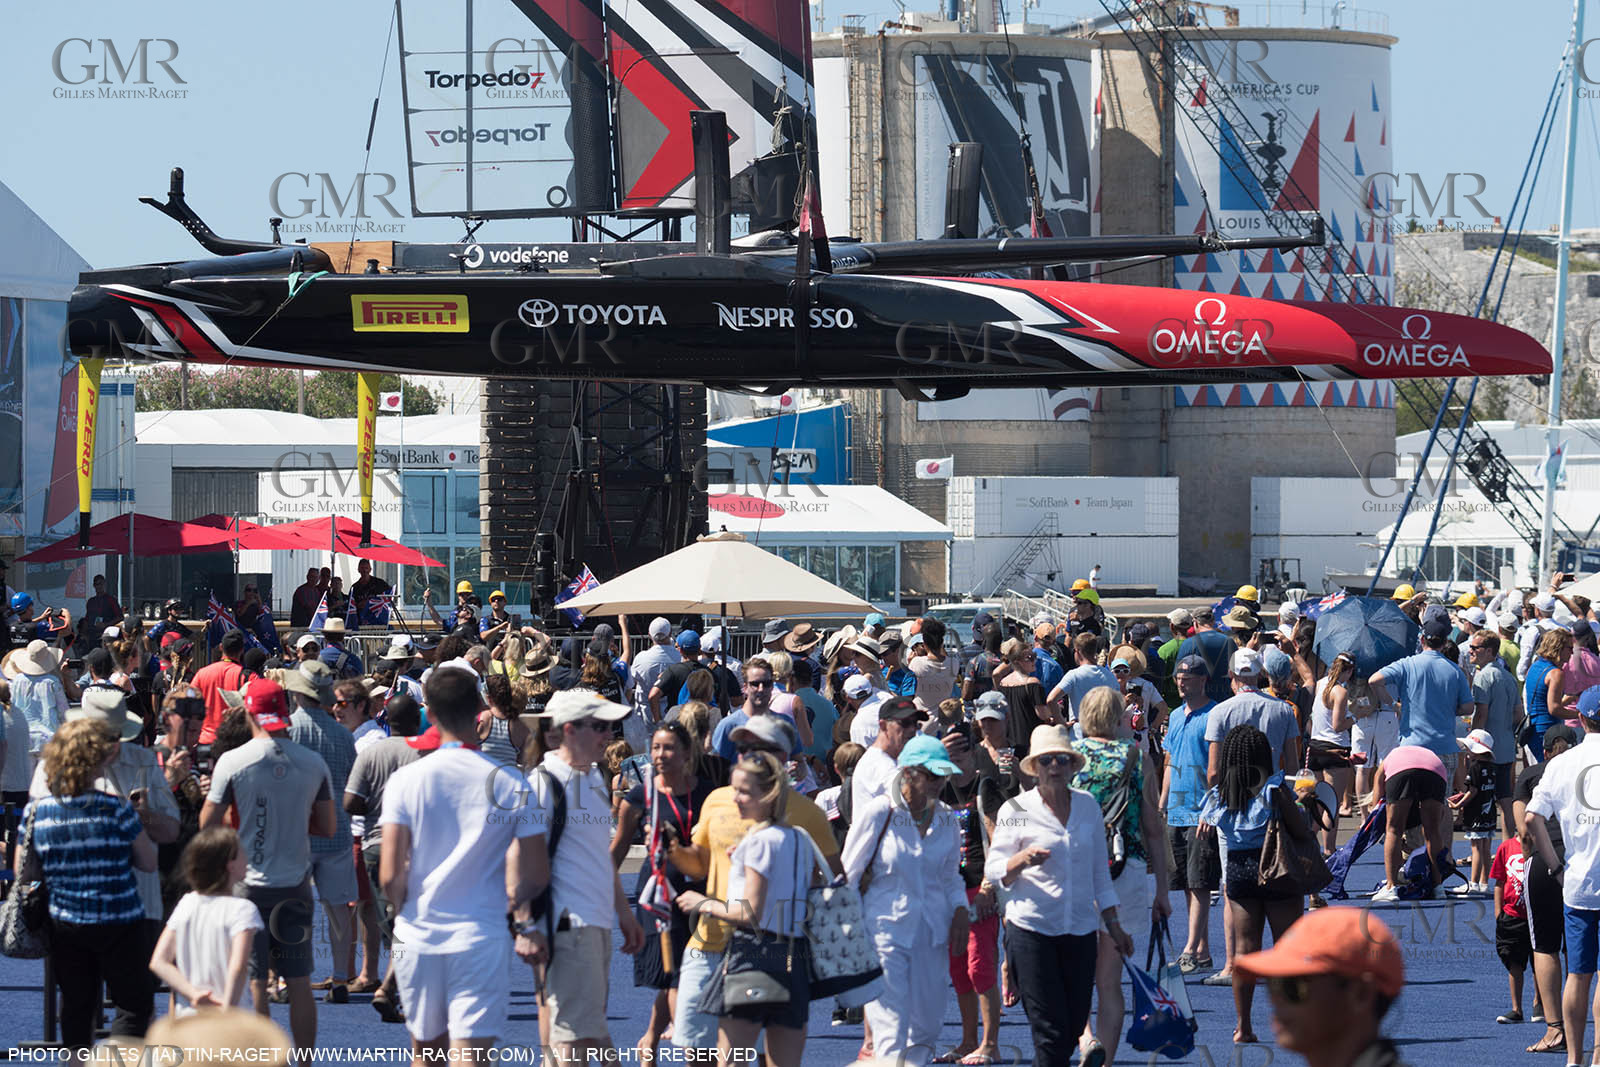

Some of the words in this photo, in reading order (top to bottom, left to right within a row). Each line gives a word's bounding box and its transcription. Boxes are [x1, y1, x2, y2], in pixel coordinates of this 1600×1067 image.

[424, 69, 546, 91] Torpedo7
[1297, 84, 1320, 96] CUP
[1218, 218, 1260, 230] LOUIS
[1266, 218, 1313, 230] VUITTO
[362, 301, 458, 325] PIRELLI
[562, 304, 667, 326] TOYOTA
[712, 302, 854, 331] NESPRSSO
[1152, 329, 1269, 355] OMEGA
[1363, 343, 1471, 367] OMEGA
[87, 388, 96, 403] P
[366, 395, 373, 412] P
[81, 411, 94, 478] ZERO
[362, 415, 373, 479] ZERO
[381, 449, 440, 464] SoftBank
[464, 451, 479, 464] Te
[1029, 497, 1069, 508] SoftBank
[1085, 497, 1108, 508] Team
[1110, 497, 1133, 510] Japan
[253, 796, 267, 865] ORACLE
